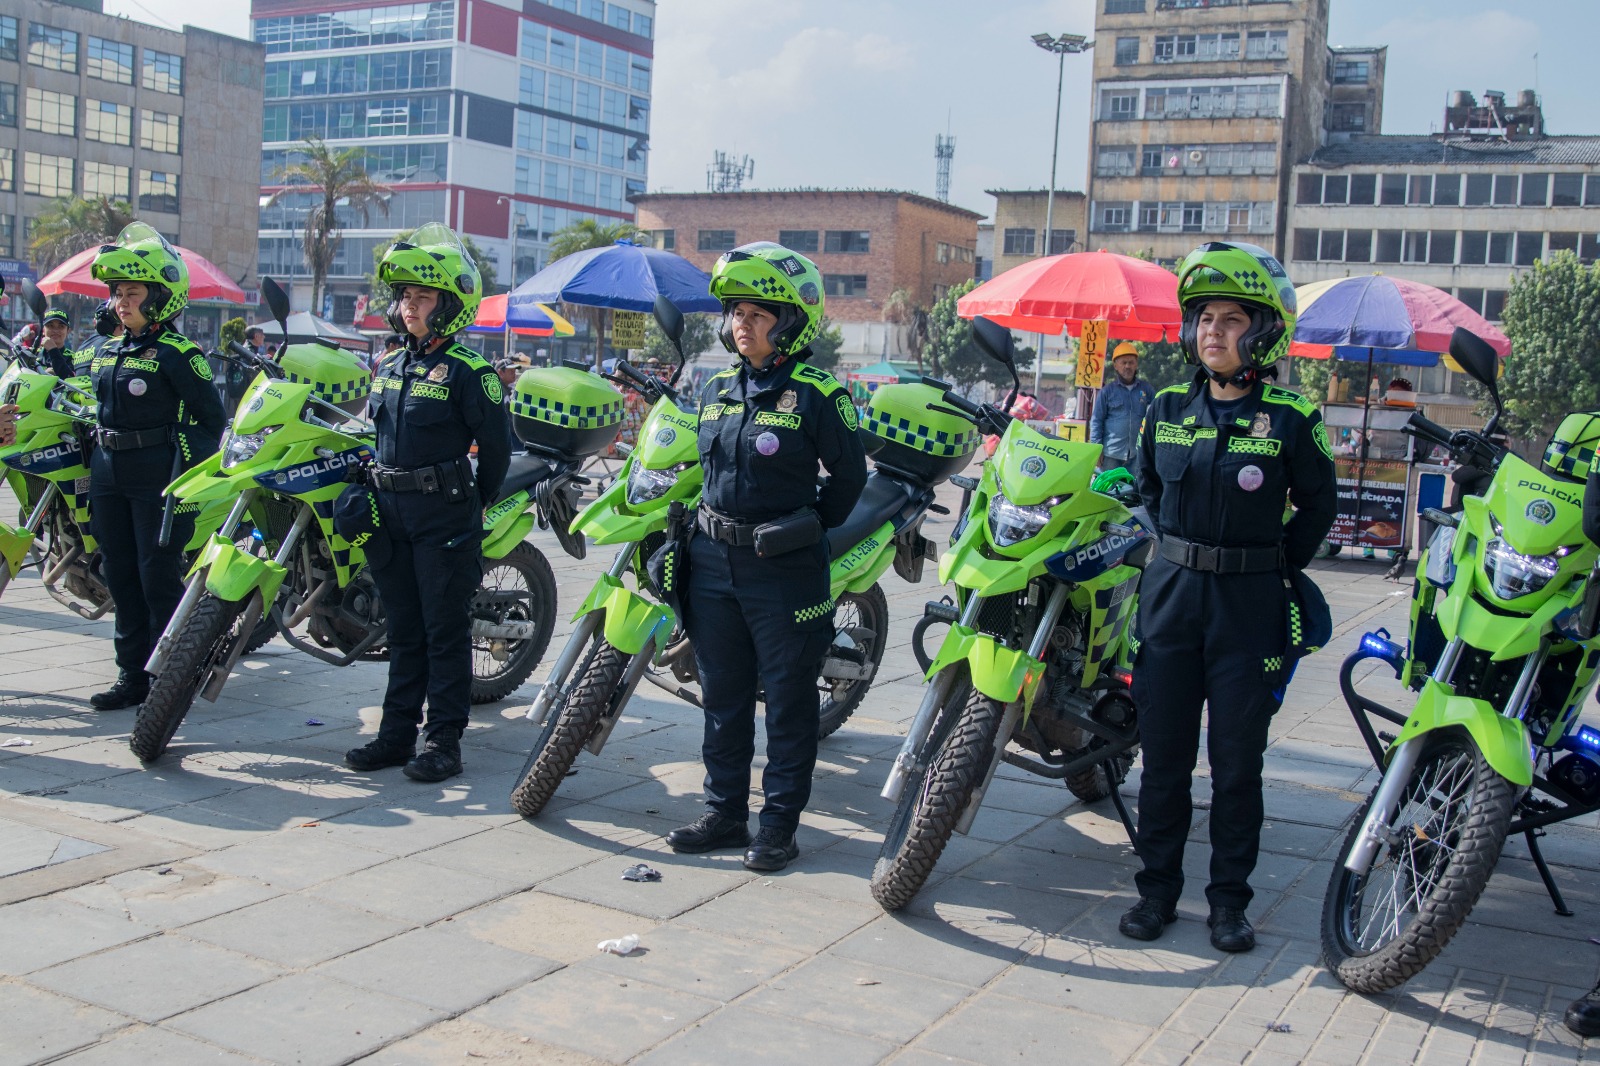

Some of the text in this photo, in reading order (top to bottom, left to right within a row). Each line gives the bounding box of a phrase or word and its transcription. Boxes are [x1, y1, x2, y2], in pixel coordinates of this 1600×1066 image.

[615, 311, 644, 320] MINUTOS
[251, 384, 283, 400] PICÍA
[415, 385, 445, 395] POLICÍA
[658, 413, 698, 433] POLICÍA
[761, 413, 796, 424] POLICÍA
[1016, 439, 1069, 462] POLICÍA
[1234, 440, 1275, 450] POLICÍA
[288, 452, 360, 481] POLICÍA
[1518, 479, 1582, 509] POLICÍA
[1351, 514, 1373, 522] BUE
[840, 537, 880, 571] 17-1-2596
